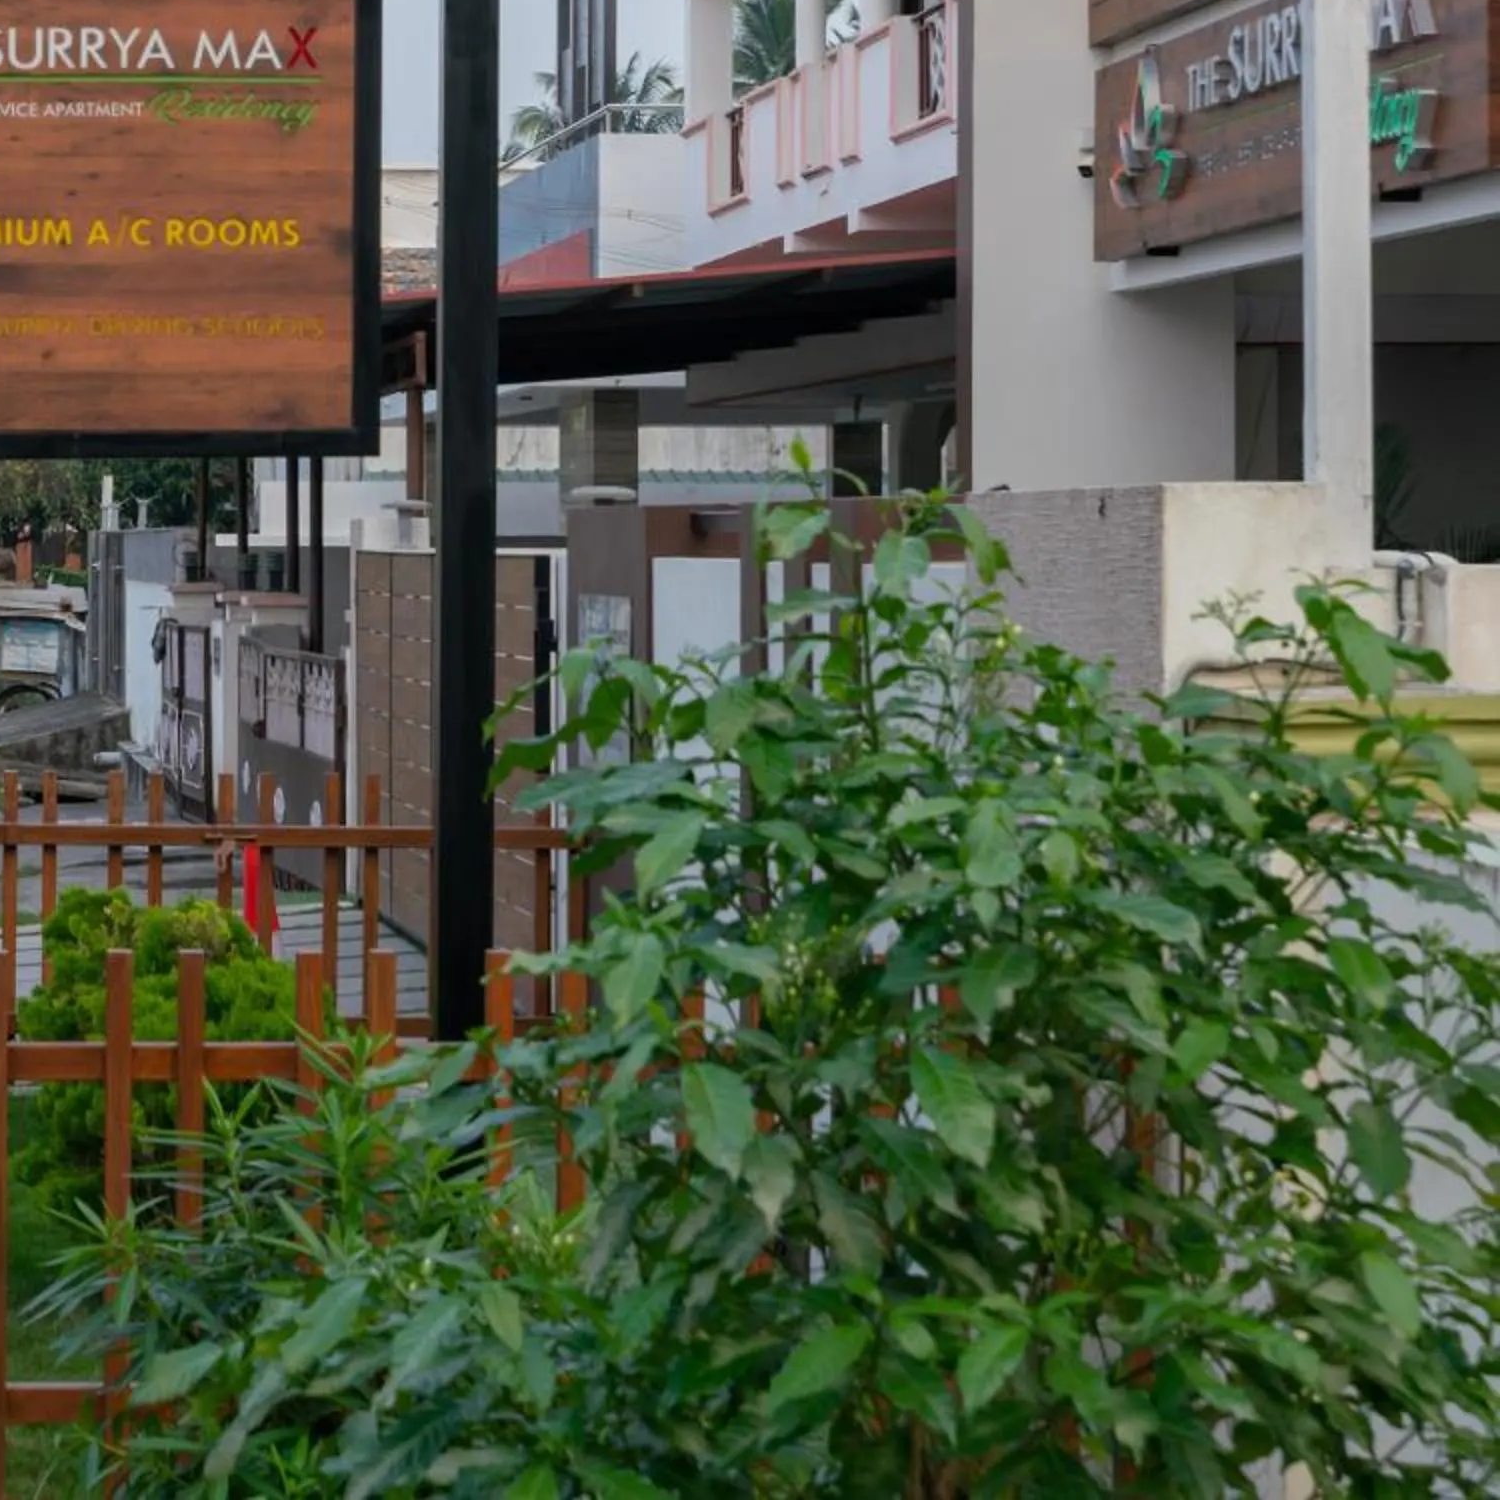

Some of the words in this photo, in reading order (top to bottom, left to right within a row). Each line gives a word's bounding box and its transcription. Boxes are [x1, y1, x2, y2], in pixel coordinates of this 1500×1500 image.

[193, 26, 318, 70] MAX
[1186, 54, 1220, 113] THE
[1228, 5, 1302, 99] SURR
[43, 101, 143, 118] APARTMENT
[145, 87, 320, 131] Residency
[87, 216, 154, 248] A/C
[165, 217, 301, 247] ROOMS
